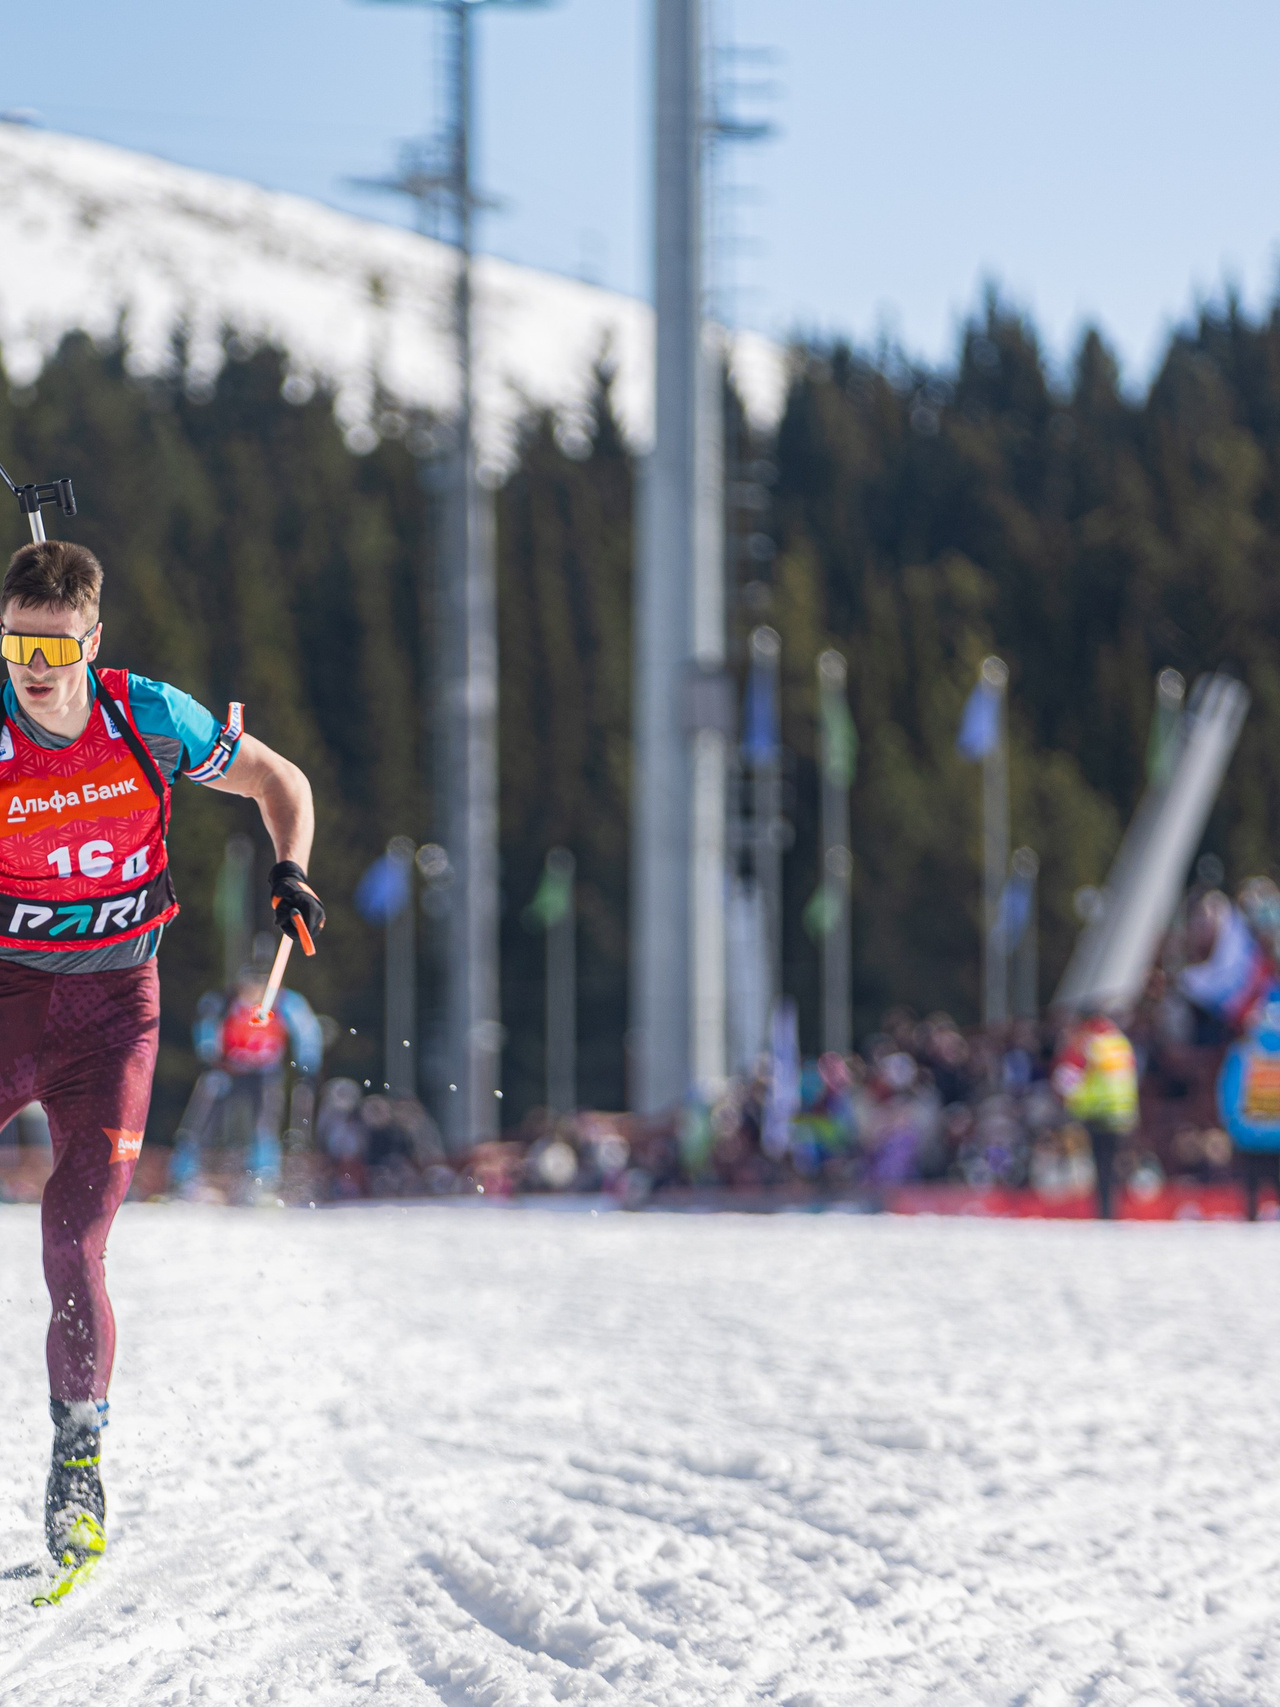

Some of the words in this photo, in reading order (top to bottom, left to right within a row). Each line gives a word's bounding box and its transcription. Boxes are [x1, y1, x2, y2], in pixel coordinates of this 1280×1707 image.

[7, 790, 80, 822] Альфа
[82, 777, 139, 803] Банк
[47, 839, 114, 878] 16
[9, 889, 148, 936] PARI
